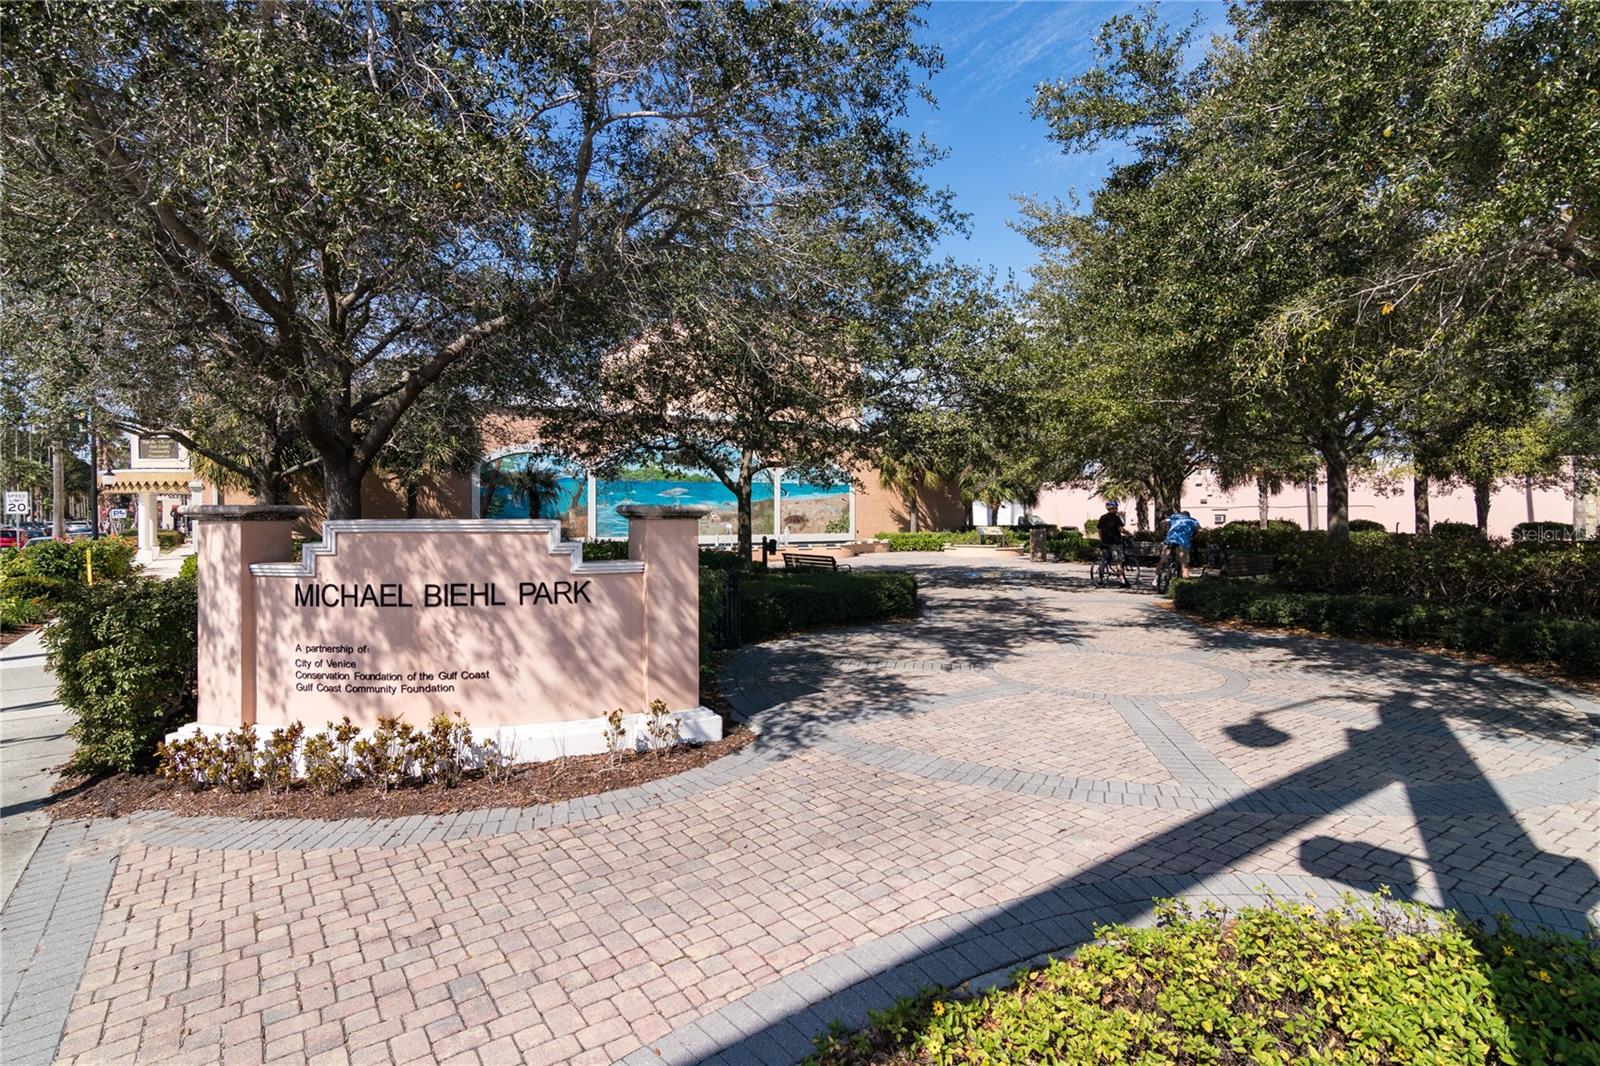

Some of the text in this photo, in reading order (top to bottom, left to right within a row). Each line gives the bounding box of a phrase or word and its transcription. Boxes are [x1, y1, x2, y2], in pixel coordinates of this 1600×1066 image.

[8, 503, 26, 512] 20
[294, 580, 592, 608] MICHAEL BIEHL PARK
[295, 643, 302, 653] A
[305, 644, 354, 655] partnership
[294, 658, 357, 670] City of Venice
[295, 670, 490, 681] Conservation Foundation of the Gulf Coast
[295, 682, 455, 696] Gulf Coast Community Foundation
